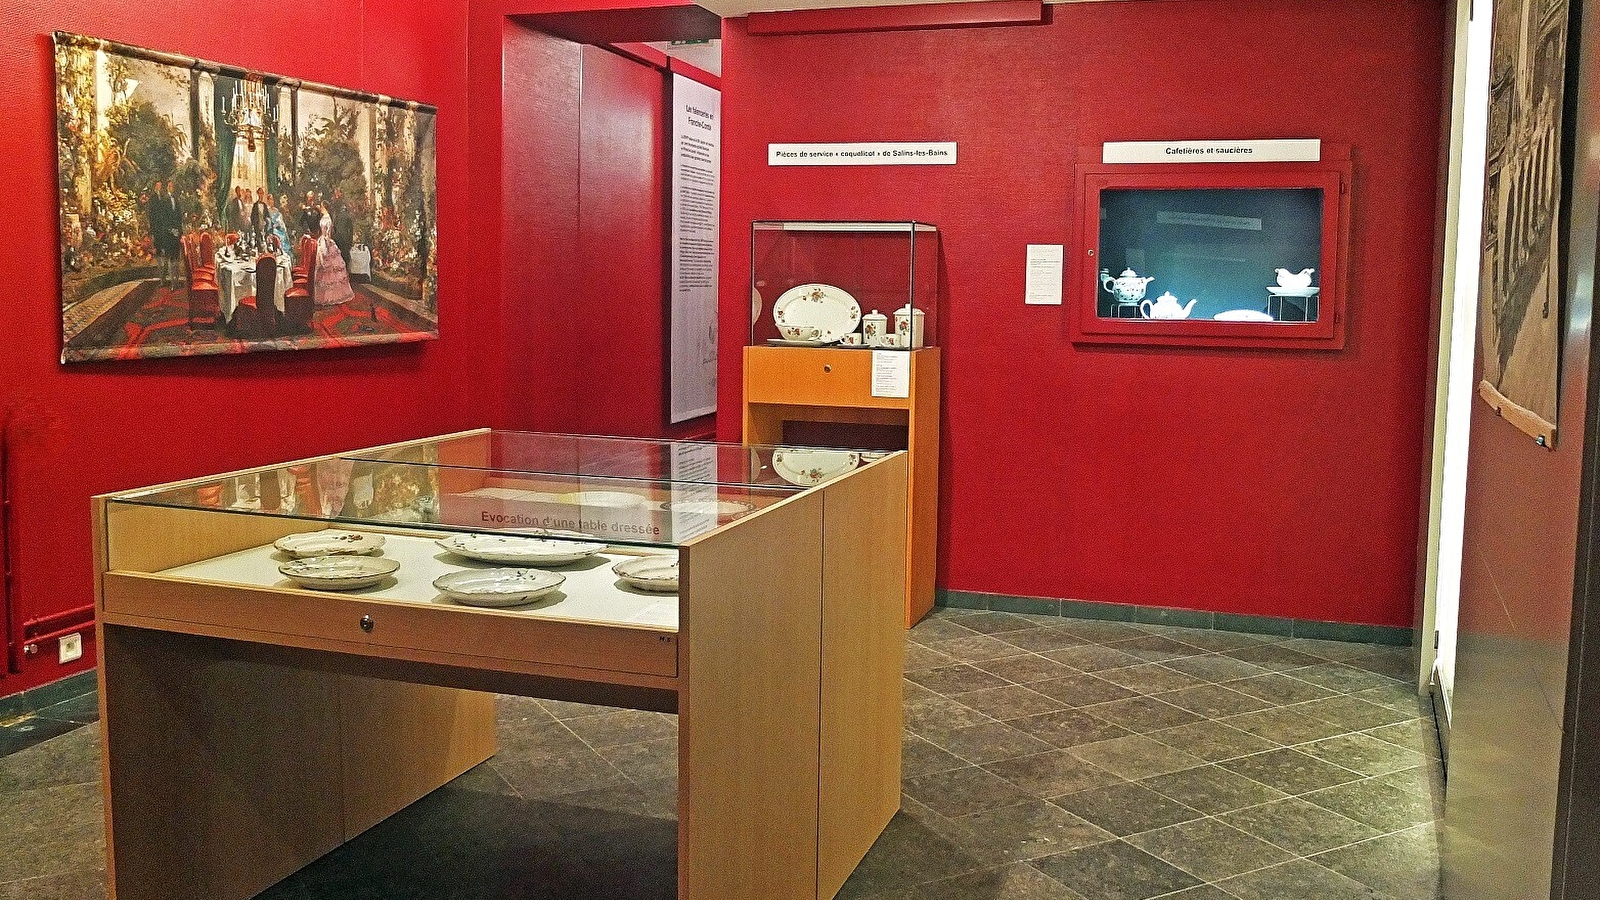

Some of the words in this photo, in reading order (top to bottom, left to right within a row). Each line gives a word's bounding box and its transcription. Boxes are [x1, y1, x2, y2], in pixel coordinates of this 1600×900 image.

[840, 150, 875, 159] coquelicot
[893, 149, 948, 157] Salins-les-Bains
[1165, 147, 1204, 155] Cafetières
[1215, 146, 1253, 154] saucières
[481, 511, 539, 527] Evocation
[542, 516, 575, 529] d'une
[578, 518, 608, 532] table
[611, 521, 660, 535] dressée
